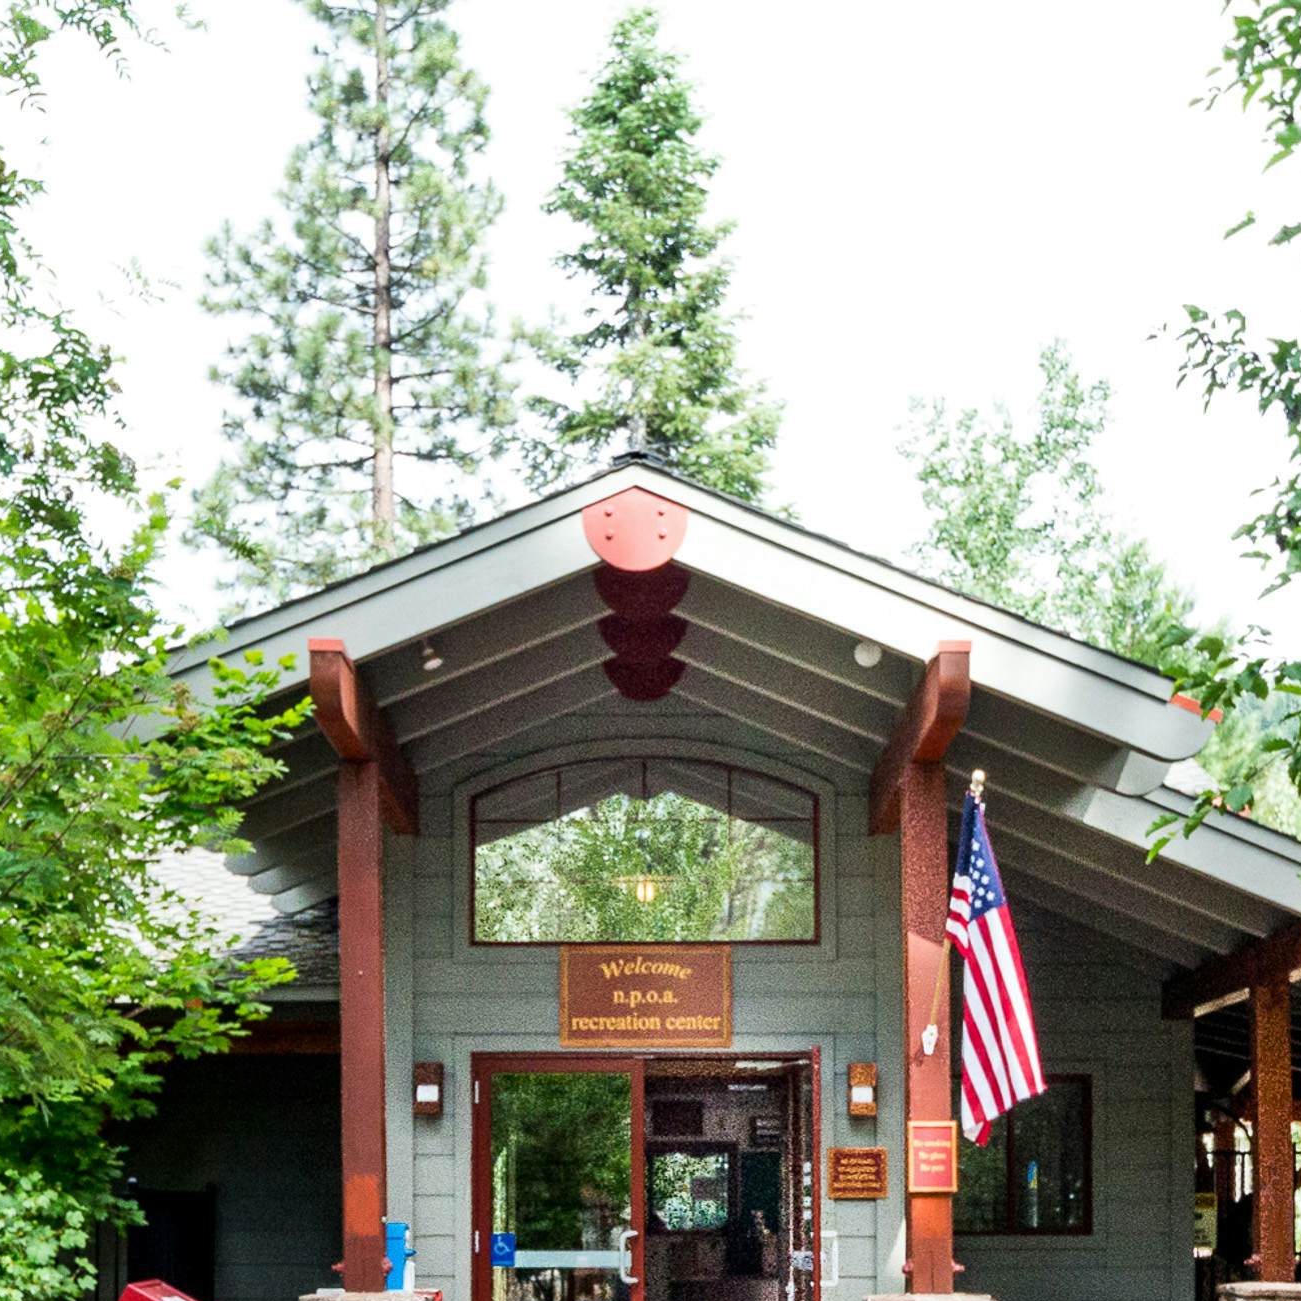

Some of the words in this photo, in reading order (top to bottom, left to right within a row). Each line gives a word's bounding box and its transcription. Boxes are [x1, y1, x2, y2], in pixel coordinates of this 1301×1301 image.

[600, 957, 693, 980] Welcome
[613, 989, 678, 1009] n.p.o.a.
[571, 1013, 661, 1031] recreation
[666, 1014, 722, 1031] center
